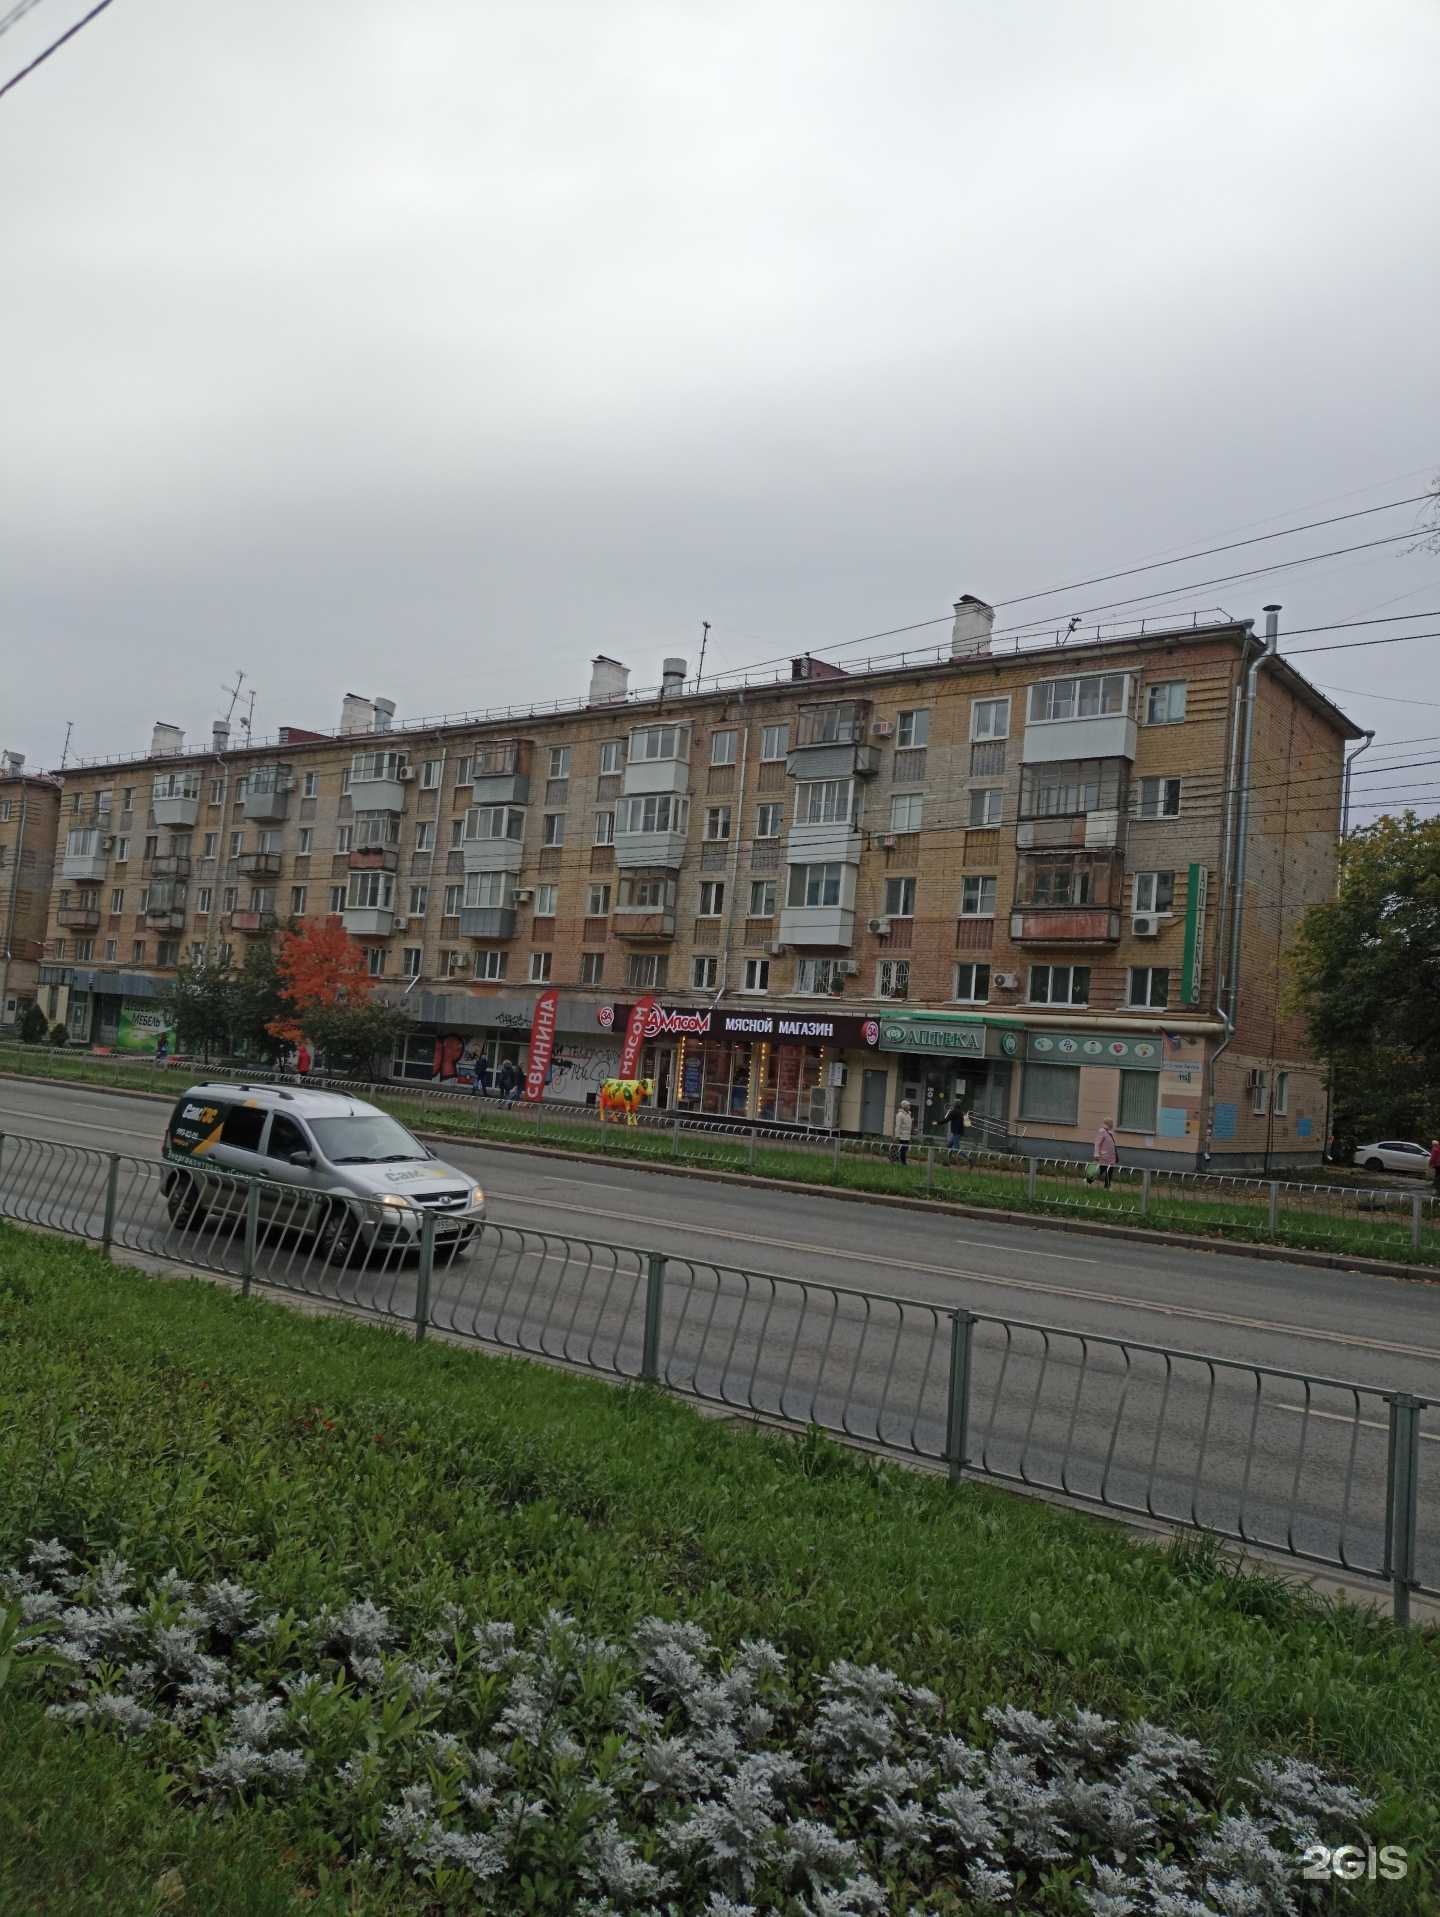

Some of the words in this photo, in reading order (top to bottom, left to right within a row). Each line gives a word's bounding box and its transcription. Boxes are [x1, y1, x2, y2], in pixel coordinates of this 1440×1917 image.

[131, 1012, 161, 1027] МЕБЕЛЬ
[725, 1016, 773, 1034] МЯСНОЙ
[779, 1020, 834, 1037] МАГАЗИН
[527, 999, 554, 1098] СВИНИНА
[622, 1006, 649, 1075] МЯСОМ
[905, 1030, 980, 1049] АПТЕКА
